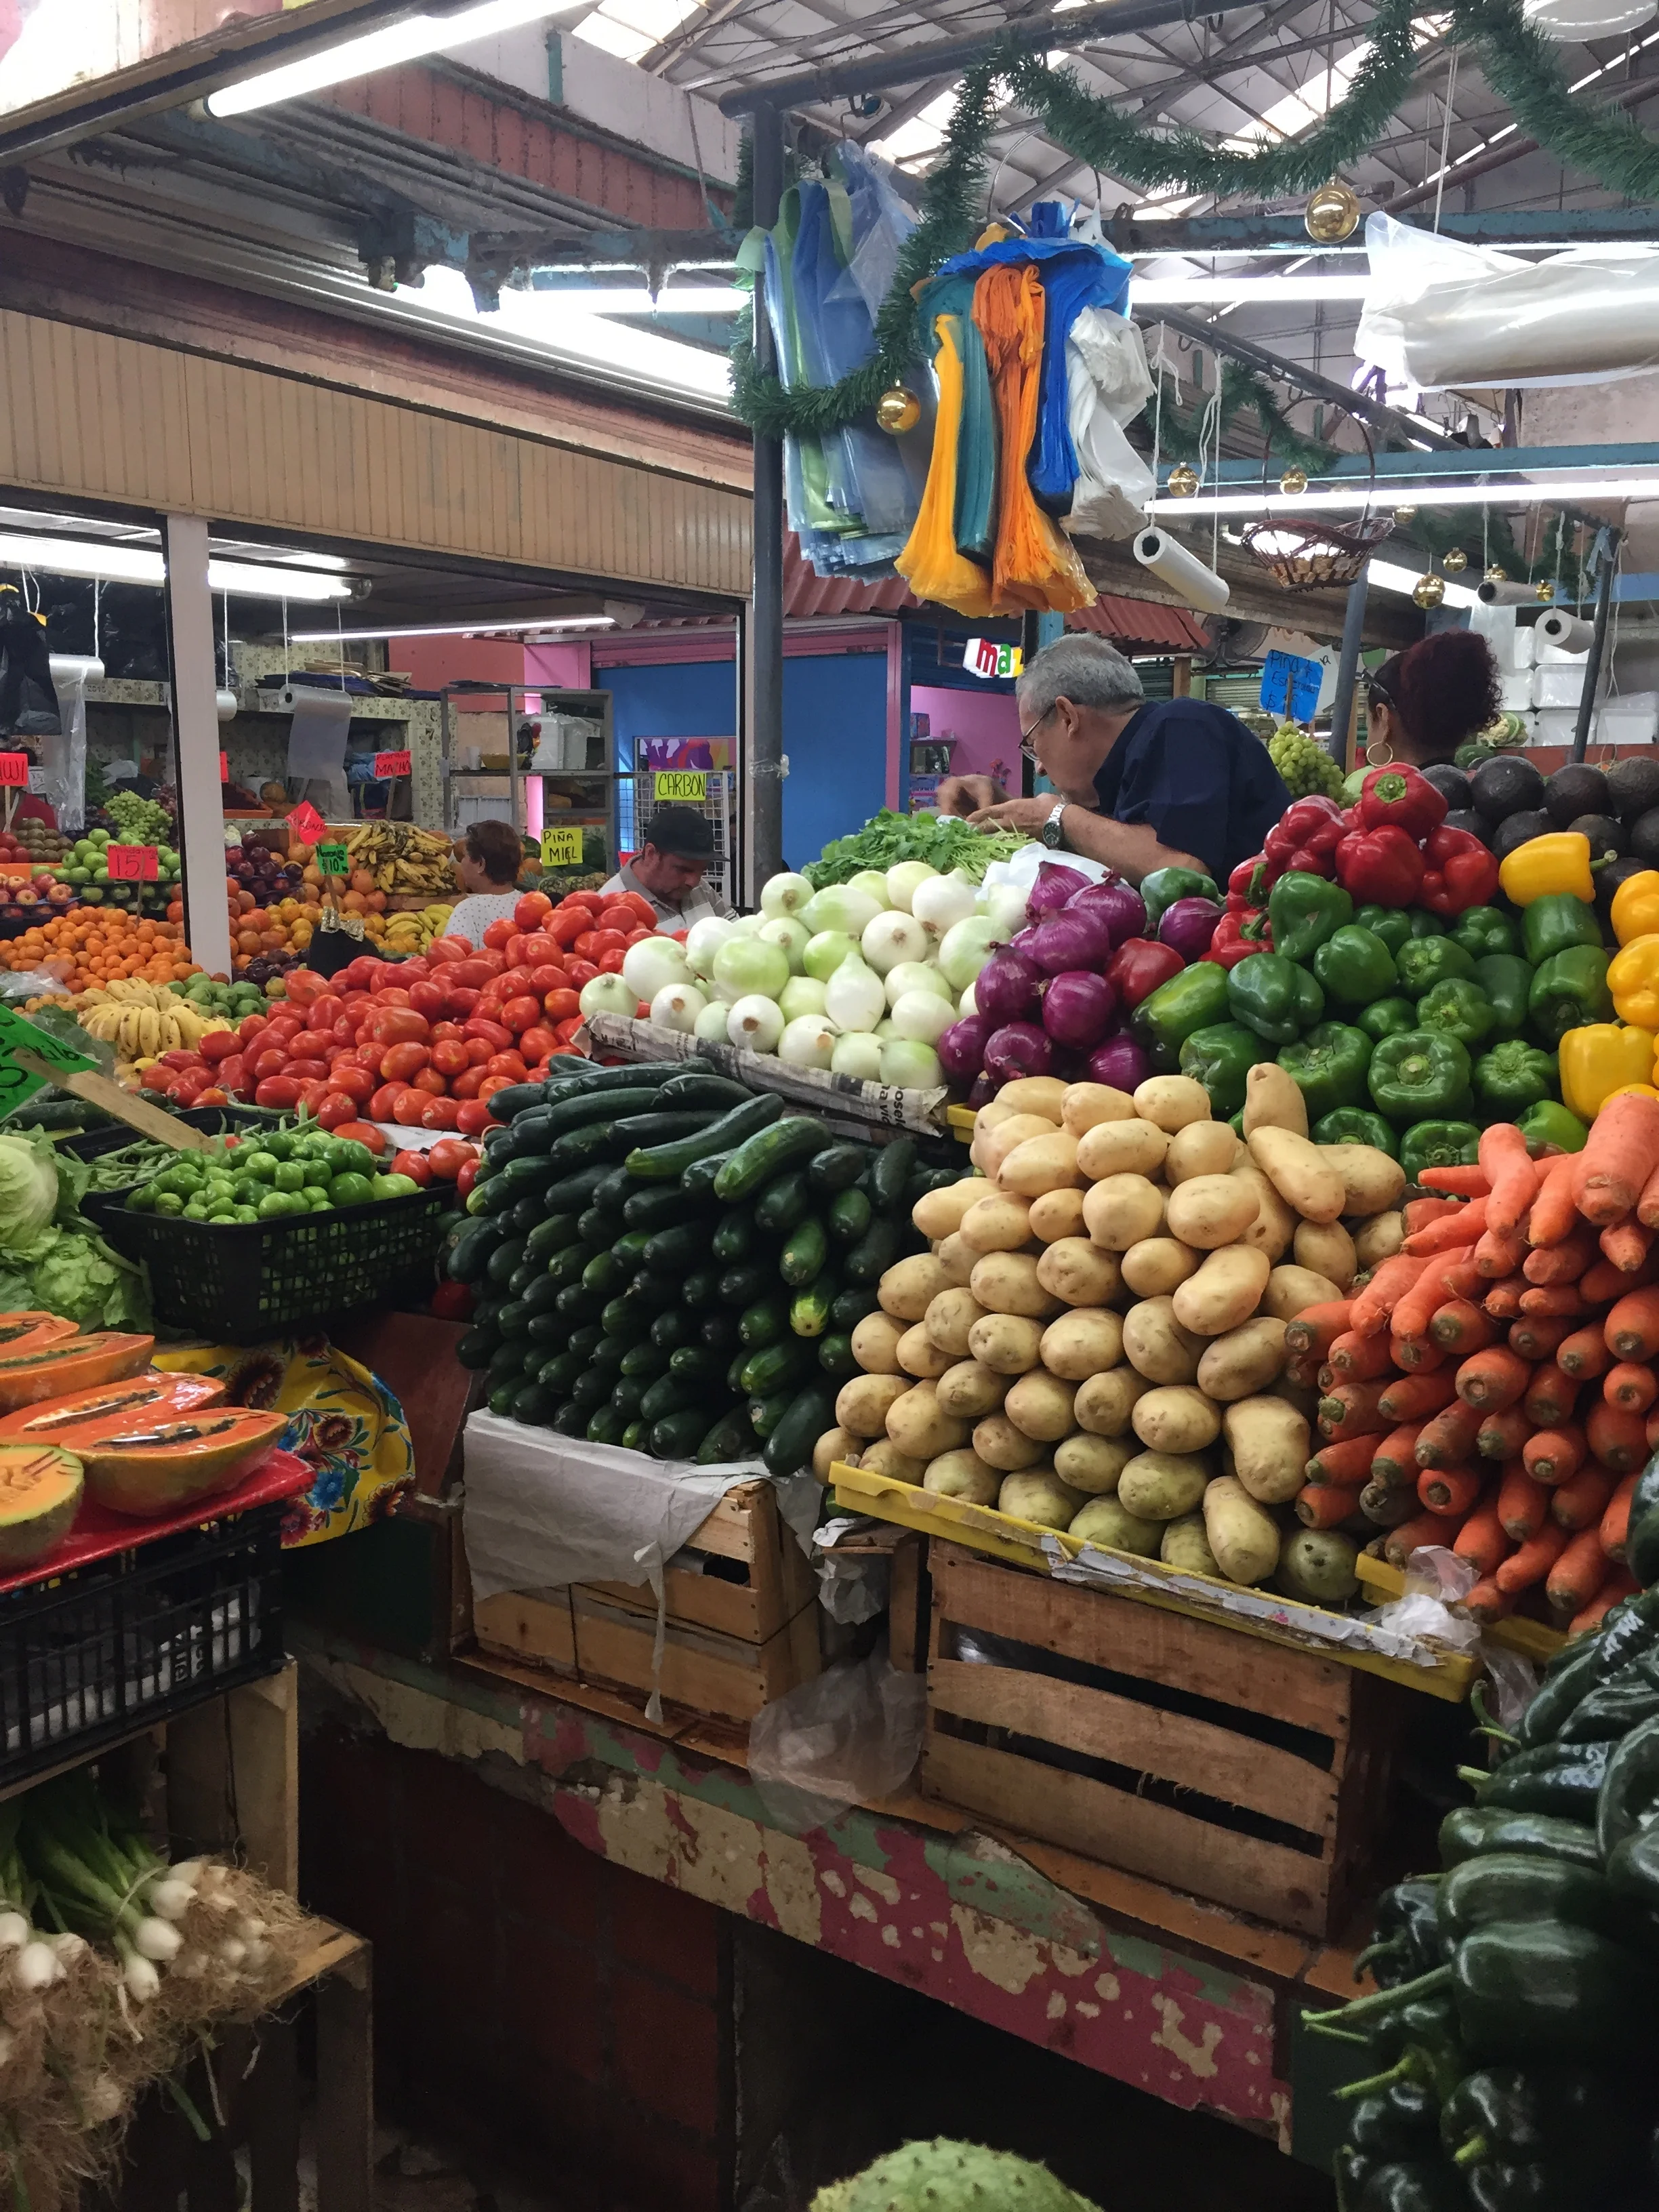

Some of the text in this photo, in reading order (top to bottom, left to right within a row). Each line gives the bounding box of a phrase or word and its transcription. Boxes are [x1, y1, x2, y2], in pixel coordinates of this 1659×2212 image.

[658, 773, 706, 798] CARBON
[543, 830, 574, 844] PIÑA
[549, 846, 578, 862] MIEL
